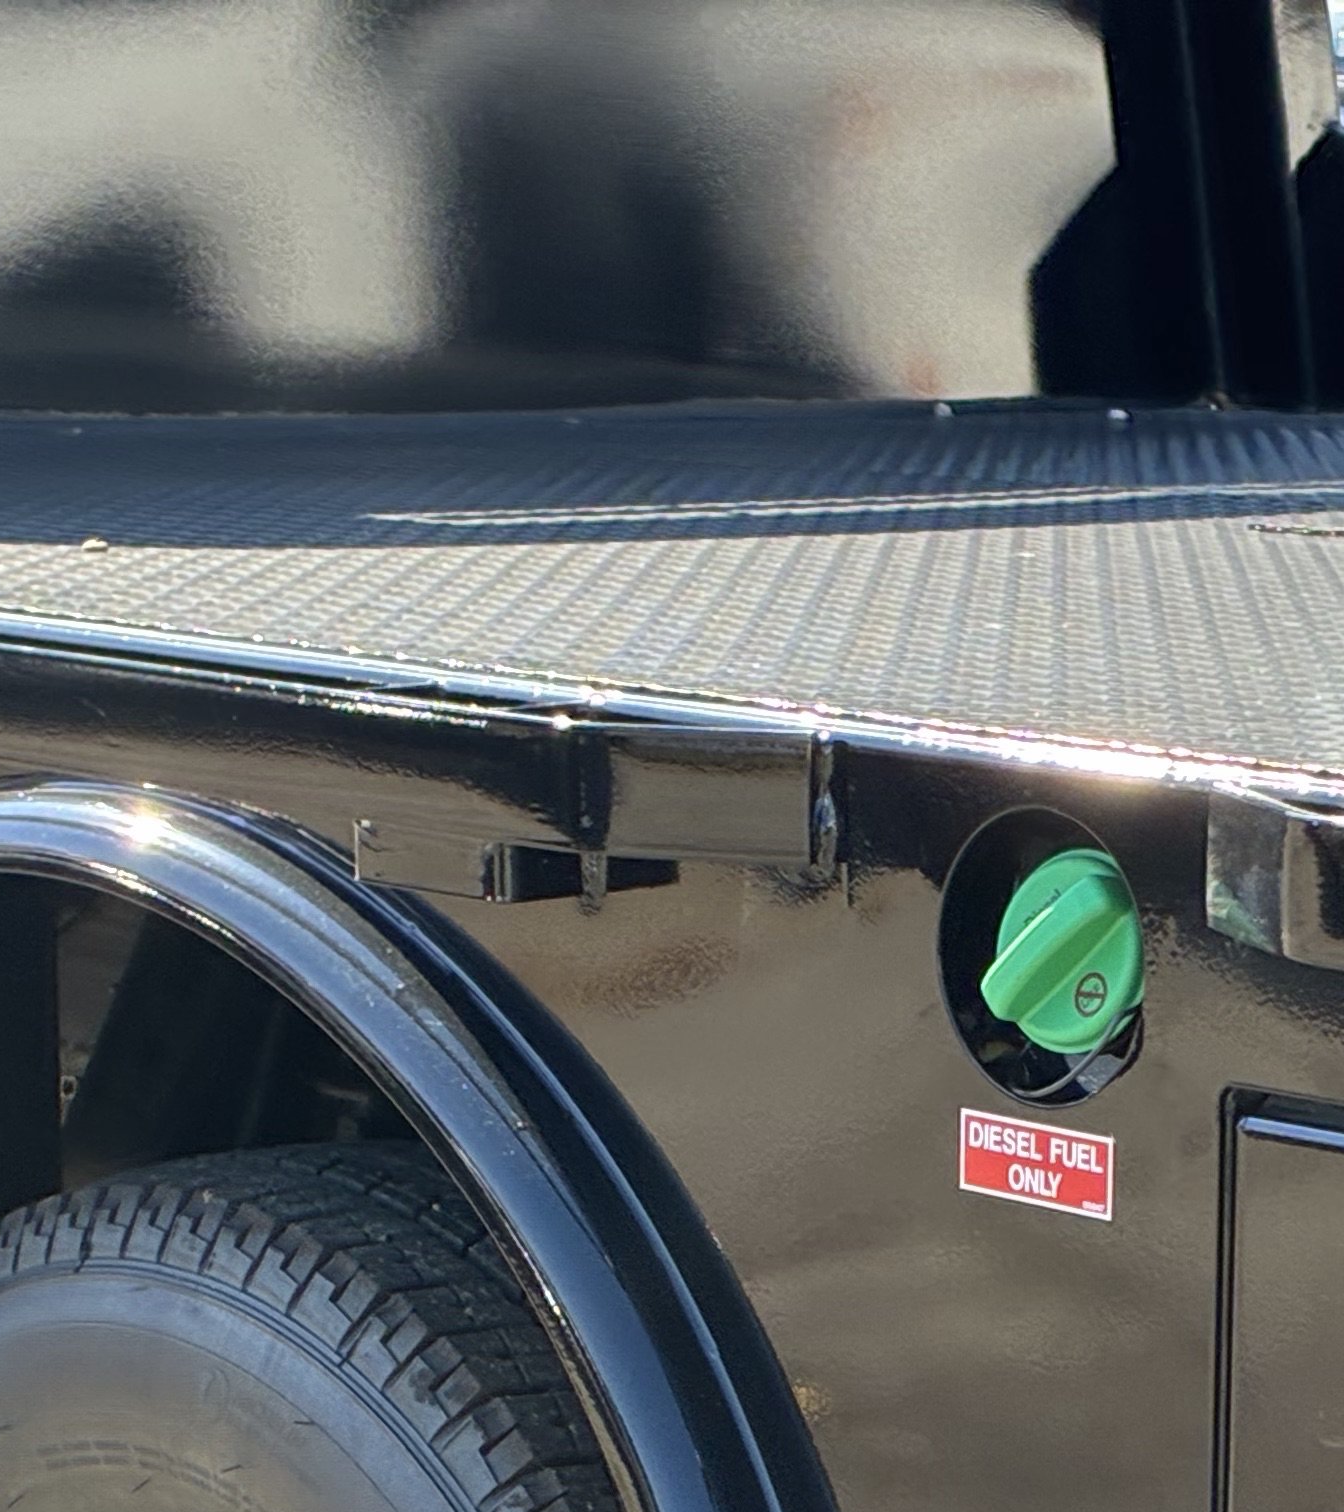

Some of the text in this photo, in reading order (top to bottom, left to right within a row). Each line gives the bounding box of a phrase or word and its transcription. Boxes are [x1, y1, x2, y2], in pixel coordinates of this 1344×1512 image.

[968, 1120, 1105, 1174] DIESEL FUEL
[1007, 1163, 1063, 1198] ONLY
